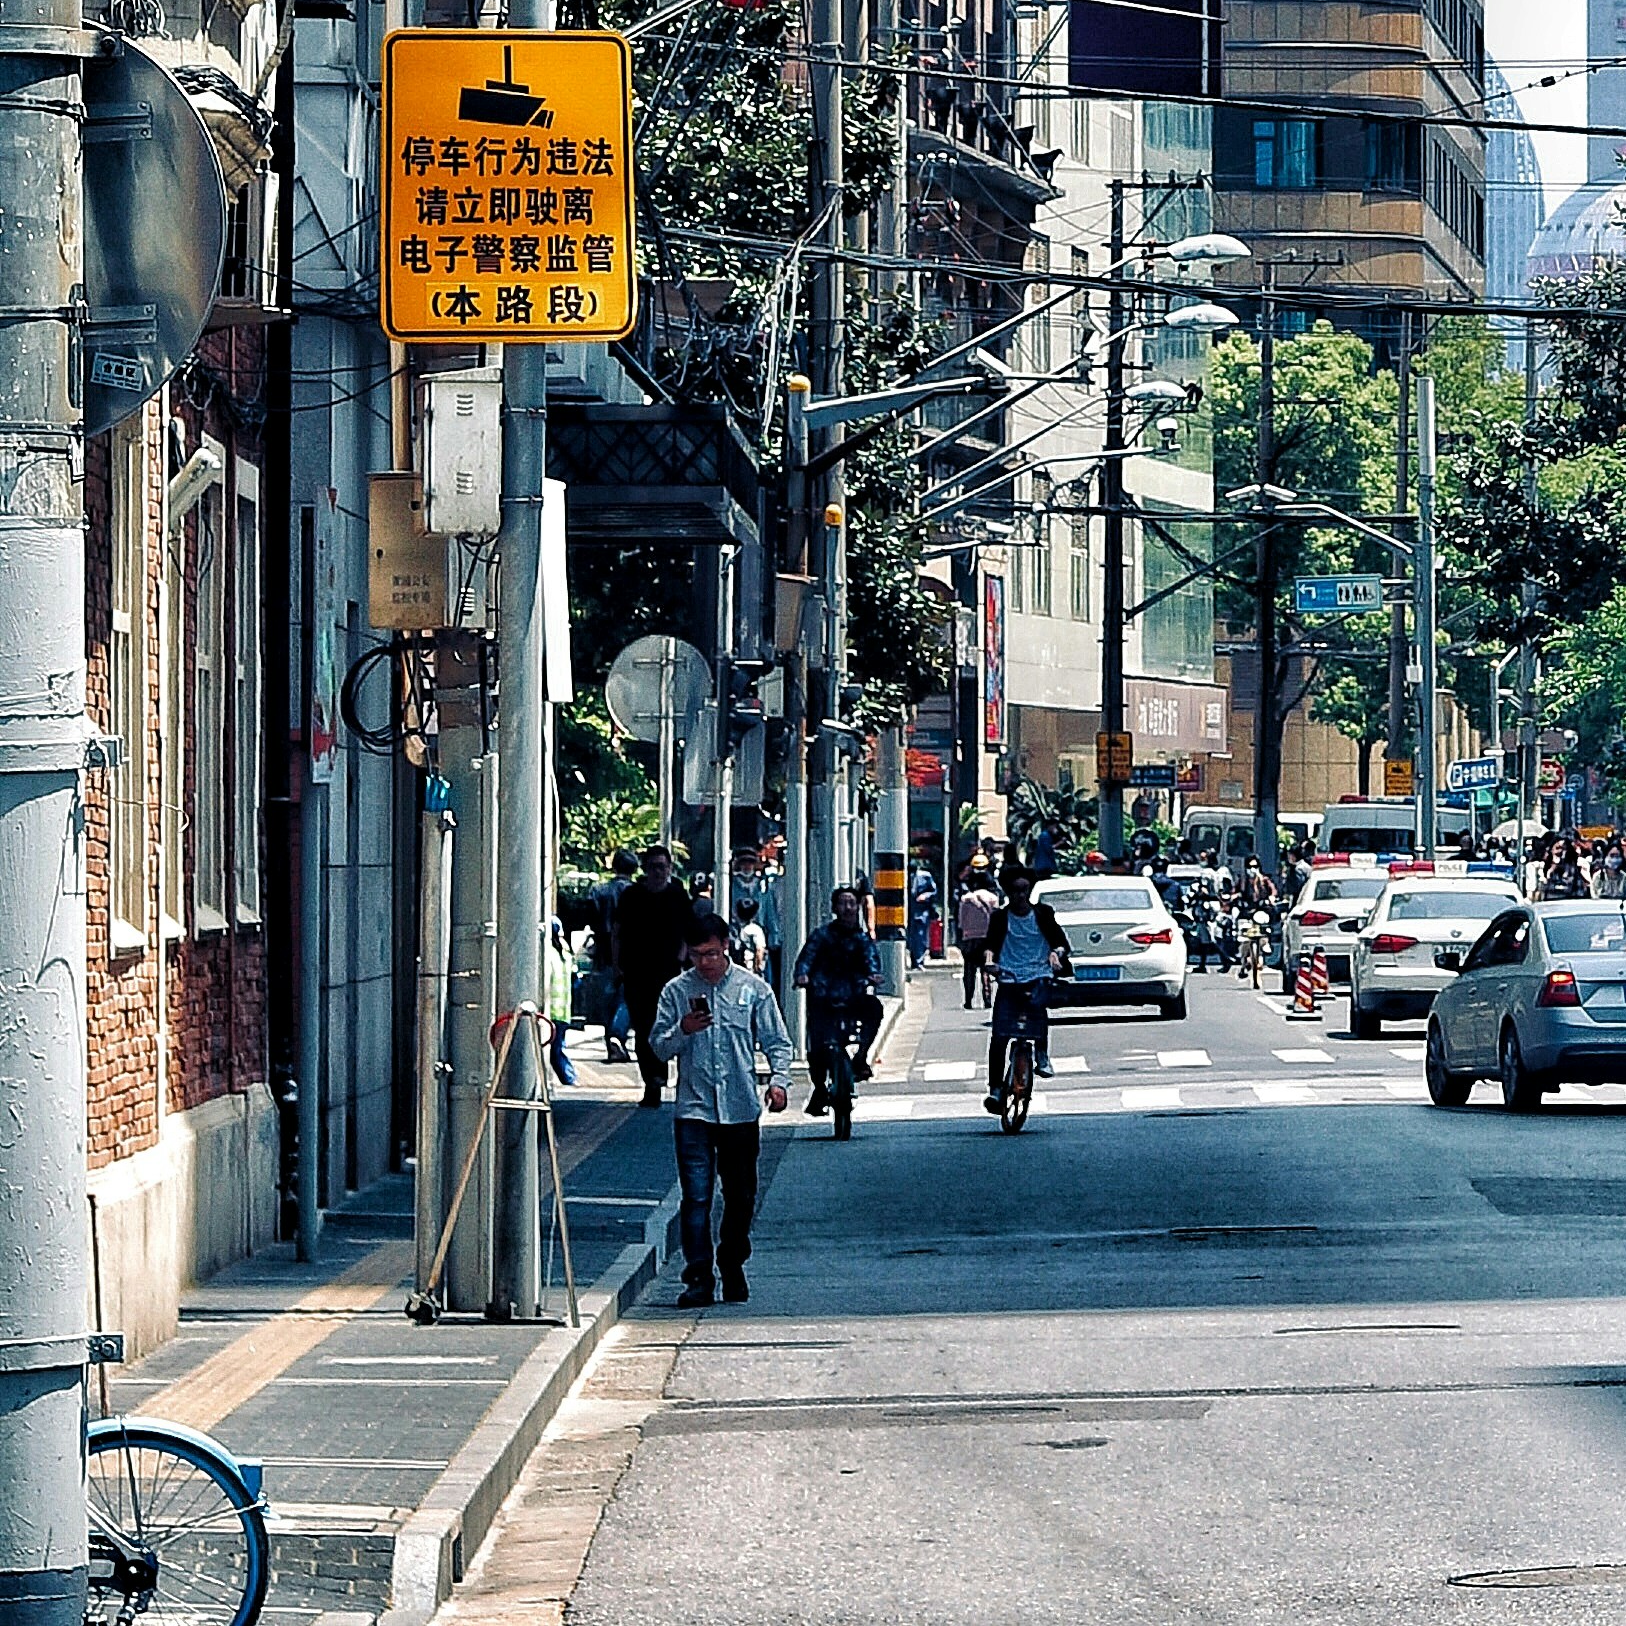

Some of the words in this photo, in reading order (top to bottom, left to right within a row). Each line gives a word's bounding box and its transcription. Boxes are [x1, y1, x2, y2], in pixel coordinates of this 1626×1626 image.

[401, 136, 615, 177] 停车行为违法
[415, 185, 591, 227] 请立即驶离
[399, 234, 615, 274] 电子警察监管
